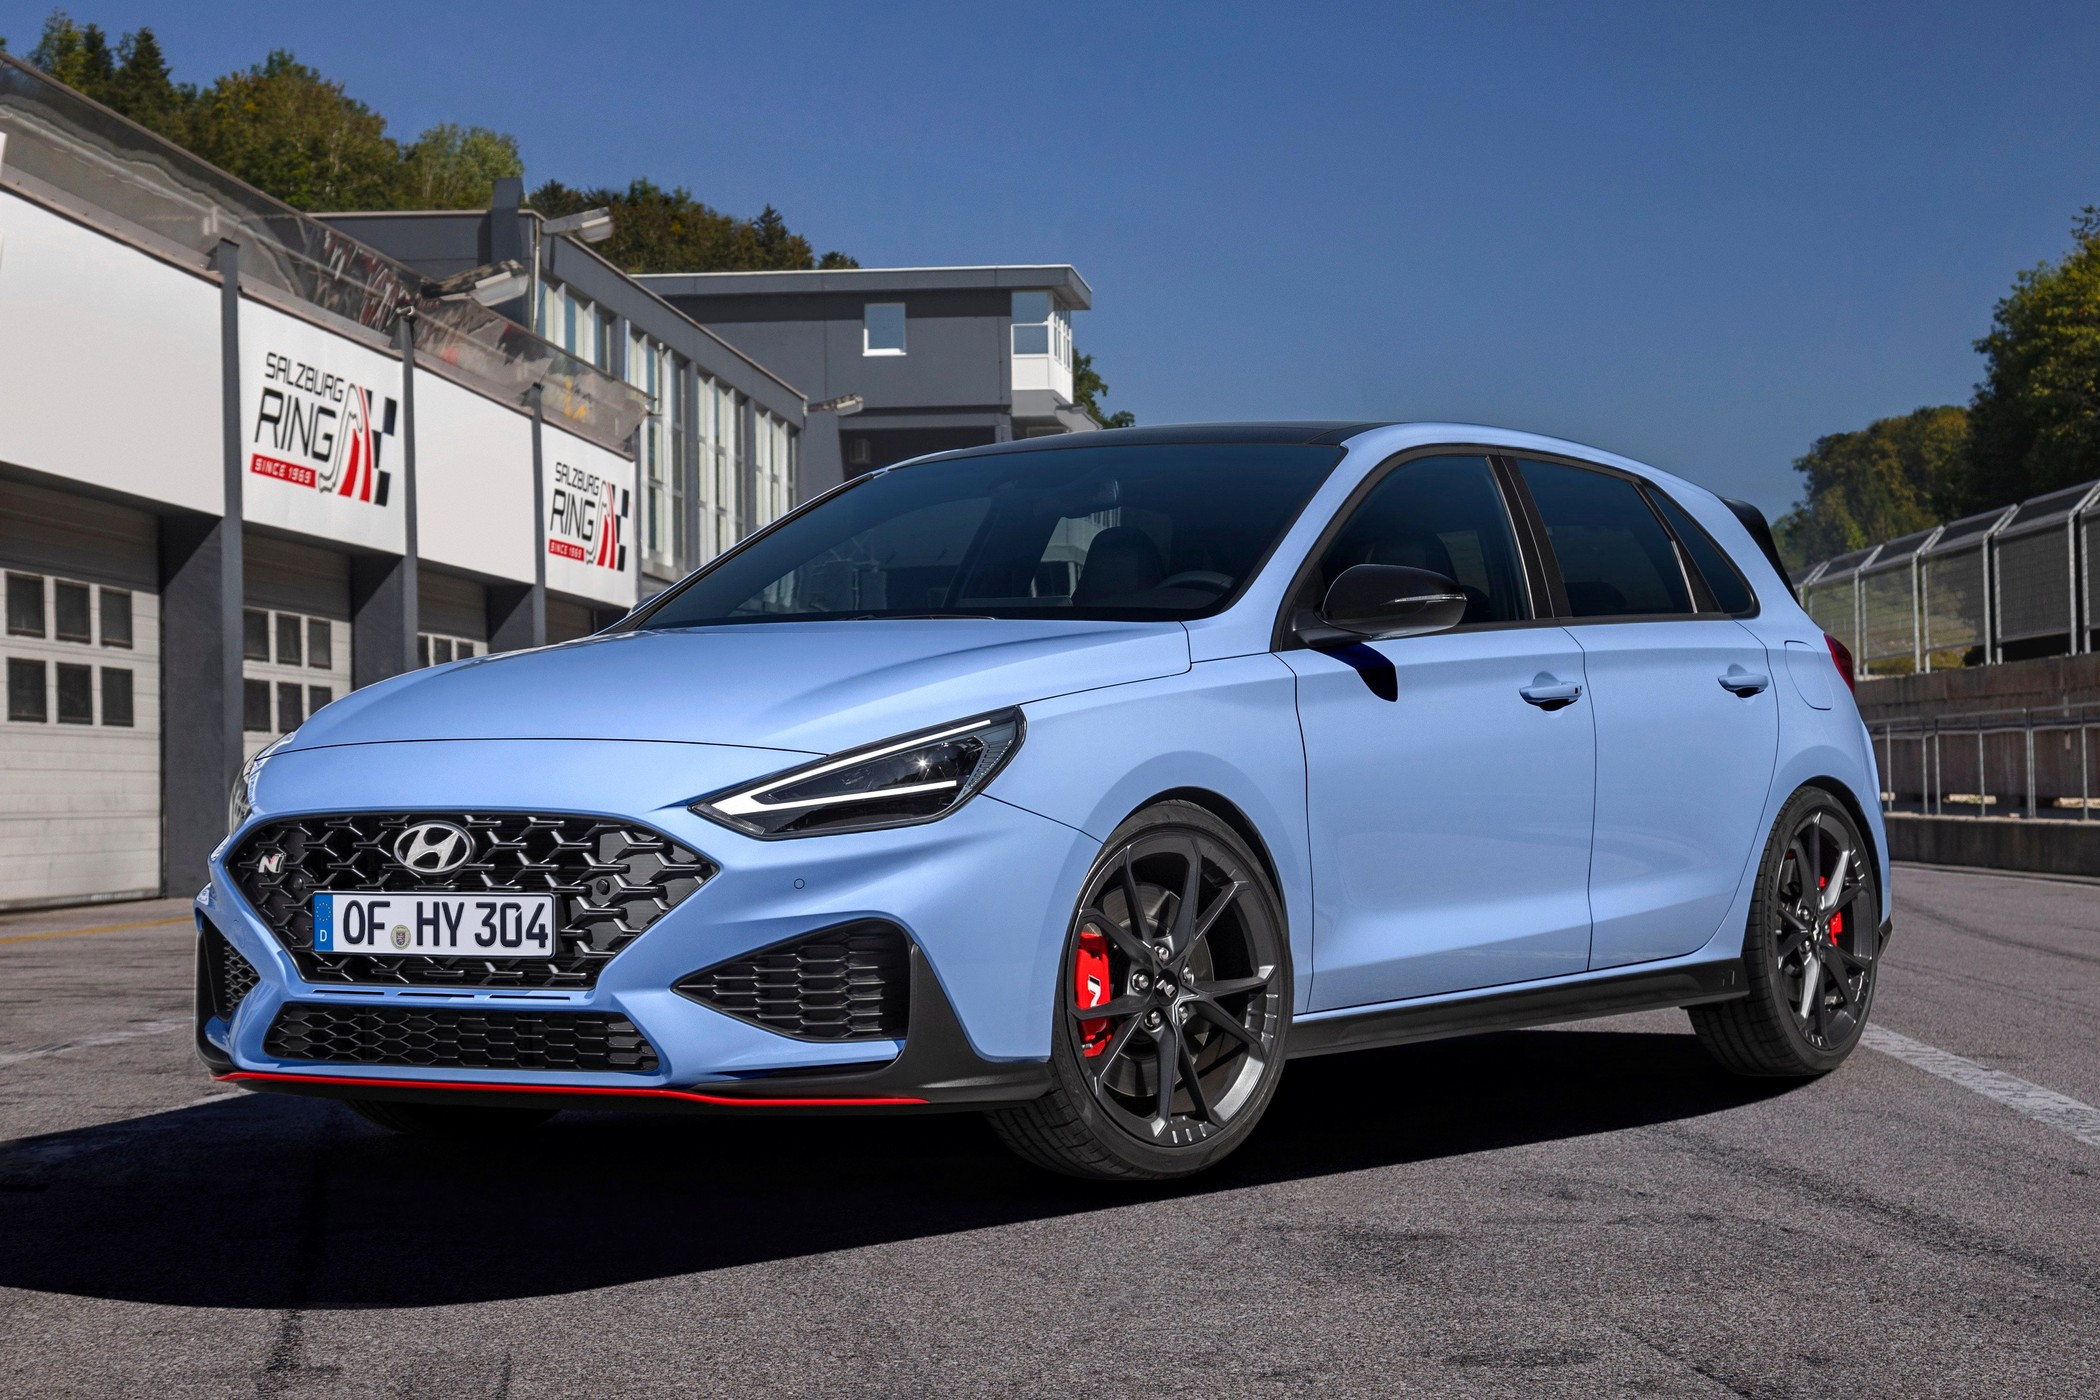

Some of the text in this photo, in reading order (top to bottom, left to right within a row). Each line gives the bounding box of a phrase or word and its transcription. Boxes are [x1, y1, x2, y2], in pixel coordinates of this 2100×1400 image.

[265, 352, 345, 403] SALZBURG
[254, 387, 337, 462] RING
[254, 458, 312, 484] SINCE 1969
[555, 462, 600, 496] SALZBURG
[550, 488, 596, 542] RING
[550, 541, 568, 555] SINCE
[320, 929, 328, 942] D
[343, 900, 391, 945] OF
[416, 902, 465, 947] HY
[475, 902, 548, 948] 304
